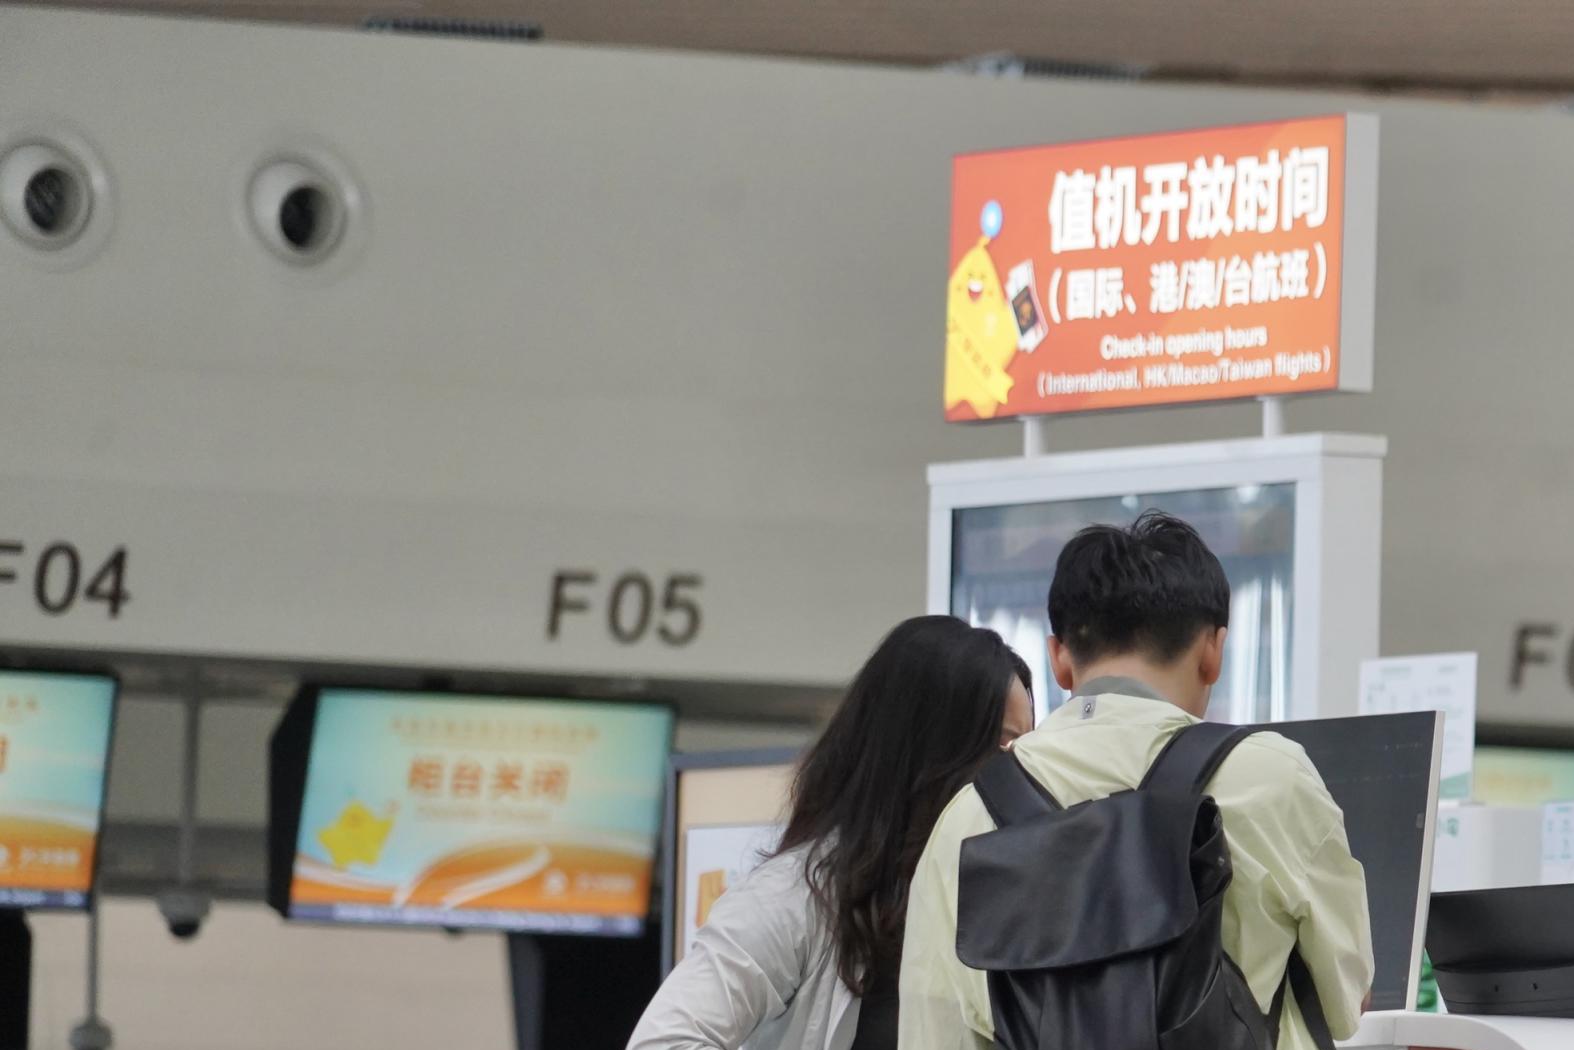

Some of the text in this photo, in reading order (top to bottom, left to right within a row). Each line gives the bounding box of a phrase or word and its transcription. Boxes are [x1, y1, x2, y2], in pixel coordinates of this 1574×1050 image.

[1048, 146, 1330, 254] 值机开放时间
[1101, 326, 1267, 359] Check-in opening hours
[547, 569, 705, 646] F05
